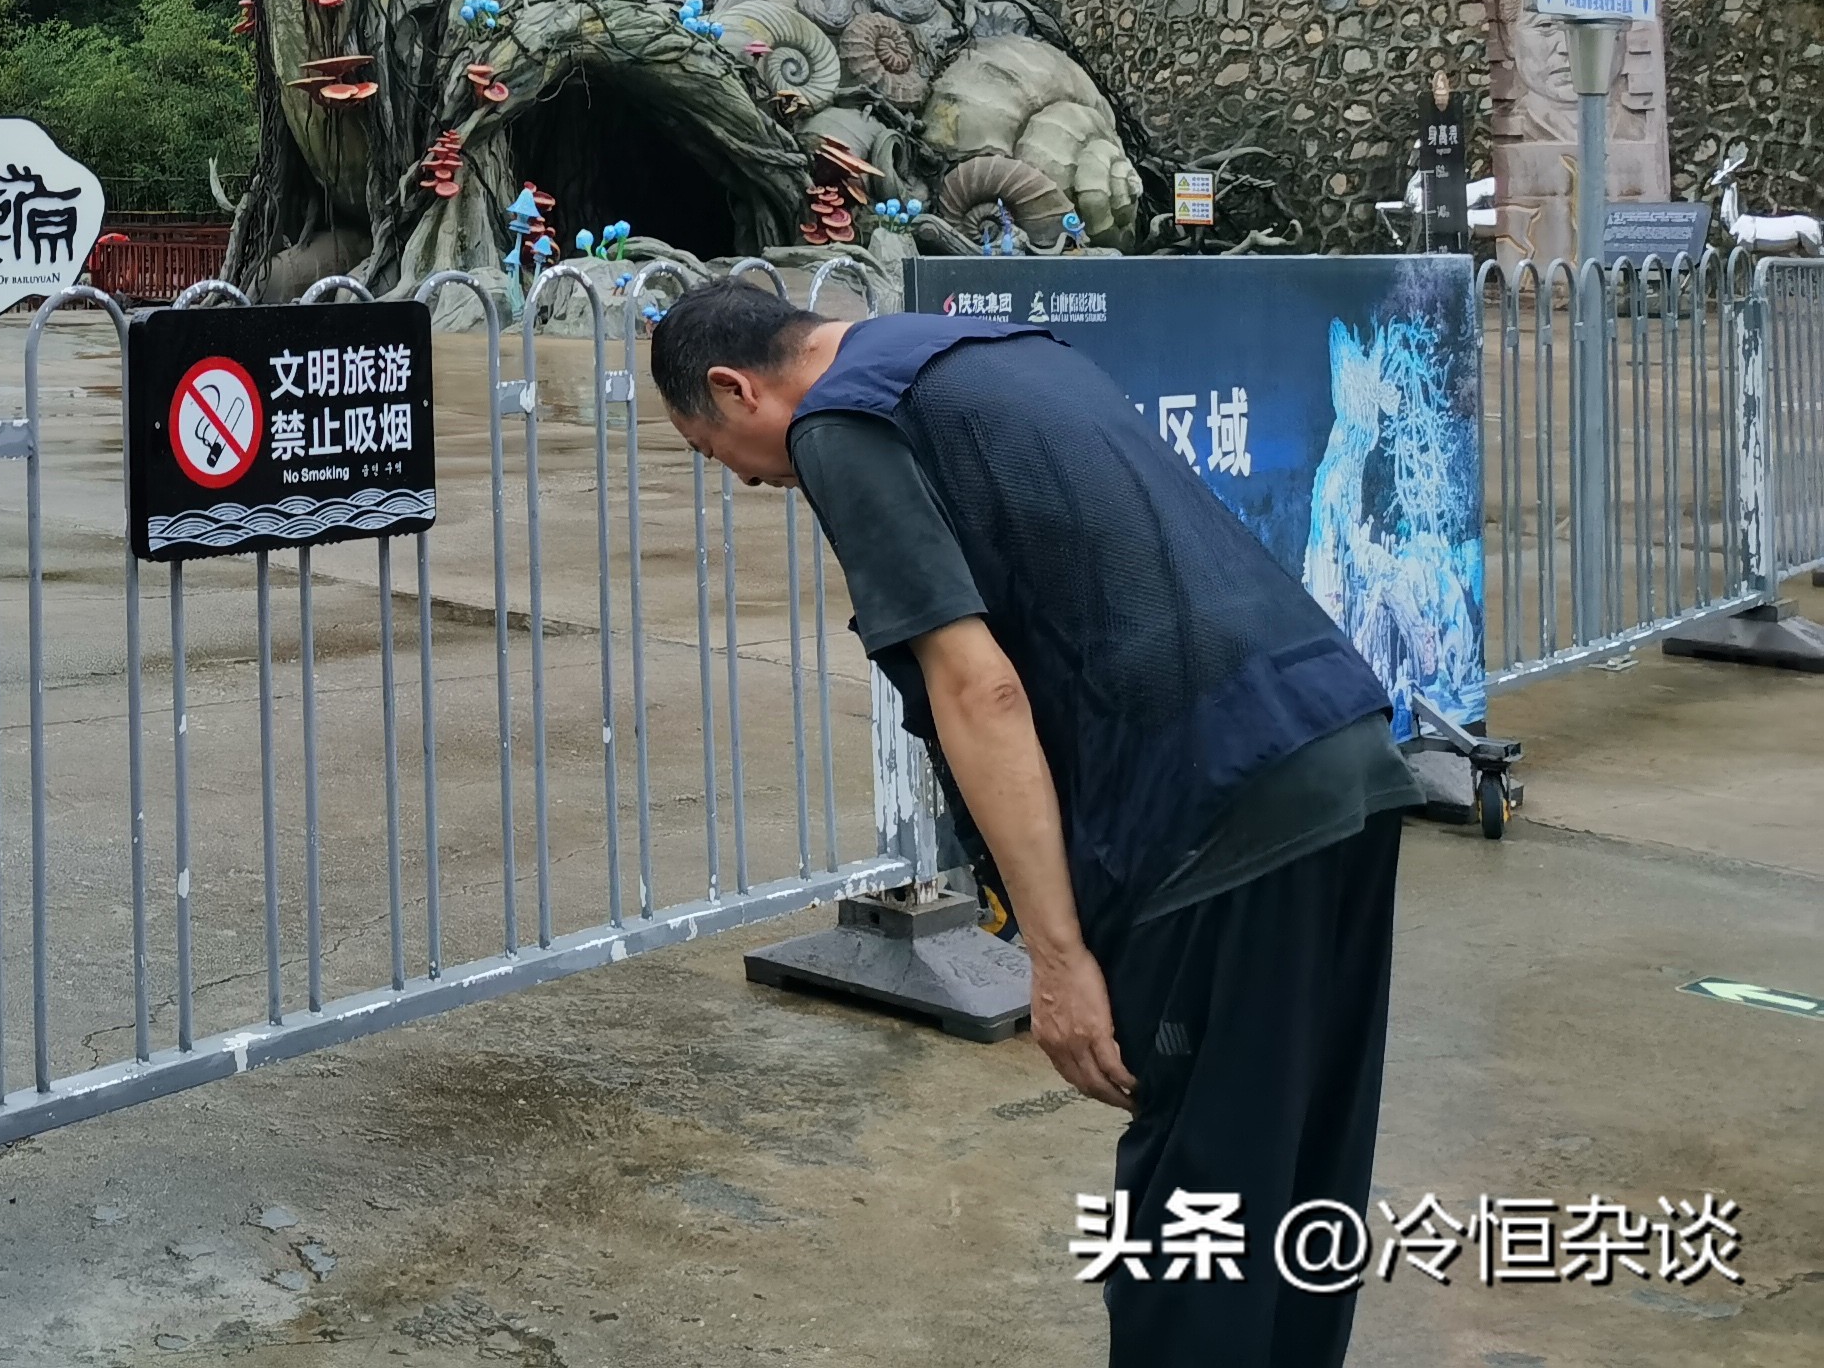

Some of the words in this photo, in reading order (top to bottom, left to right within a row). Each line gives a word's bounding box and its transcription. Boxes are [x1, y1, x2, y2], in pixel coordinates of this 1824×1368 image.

[1428, 124, 1459, 146] 身高表
[958, 292, 1013, 314] 陕旅集团
[269, 343, 412, 400] 文明旅游
[270, 402, 413, 461] 禁止吸烟
[283, 468, 300, 484] No
[301, 465, 350, 484] Smoking
